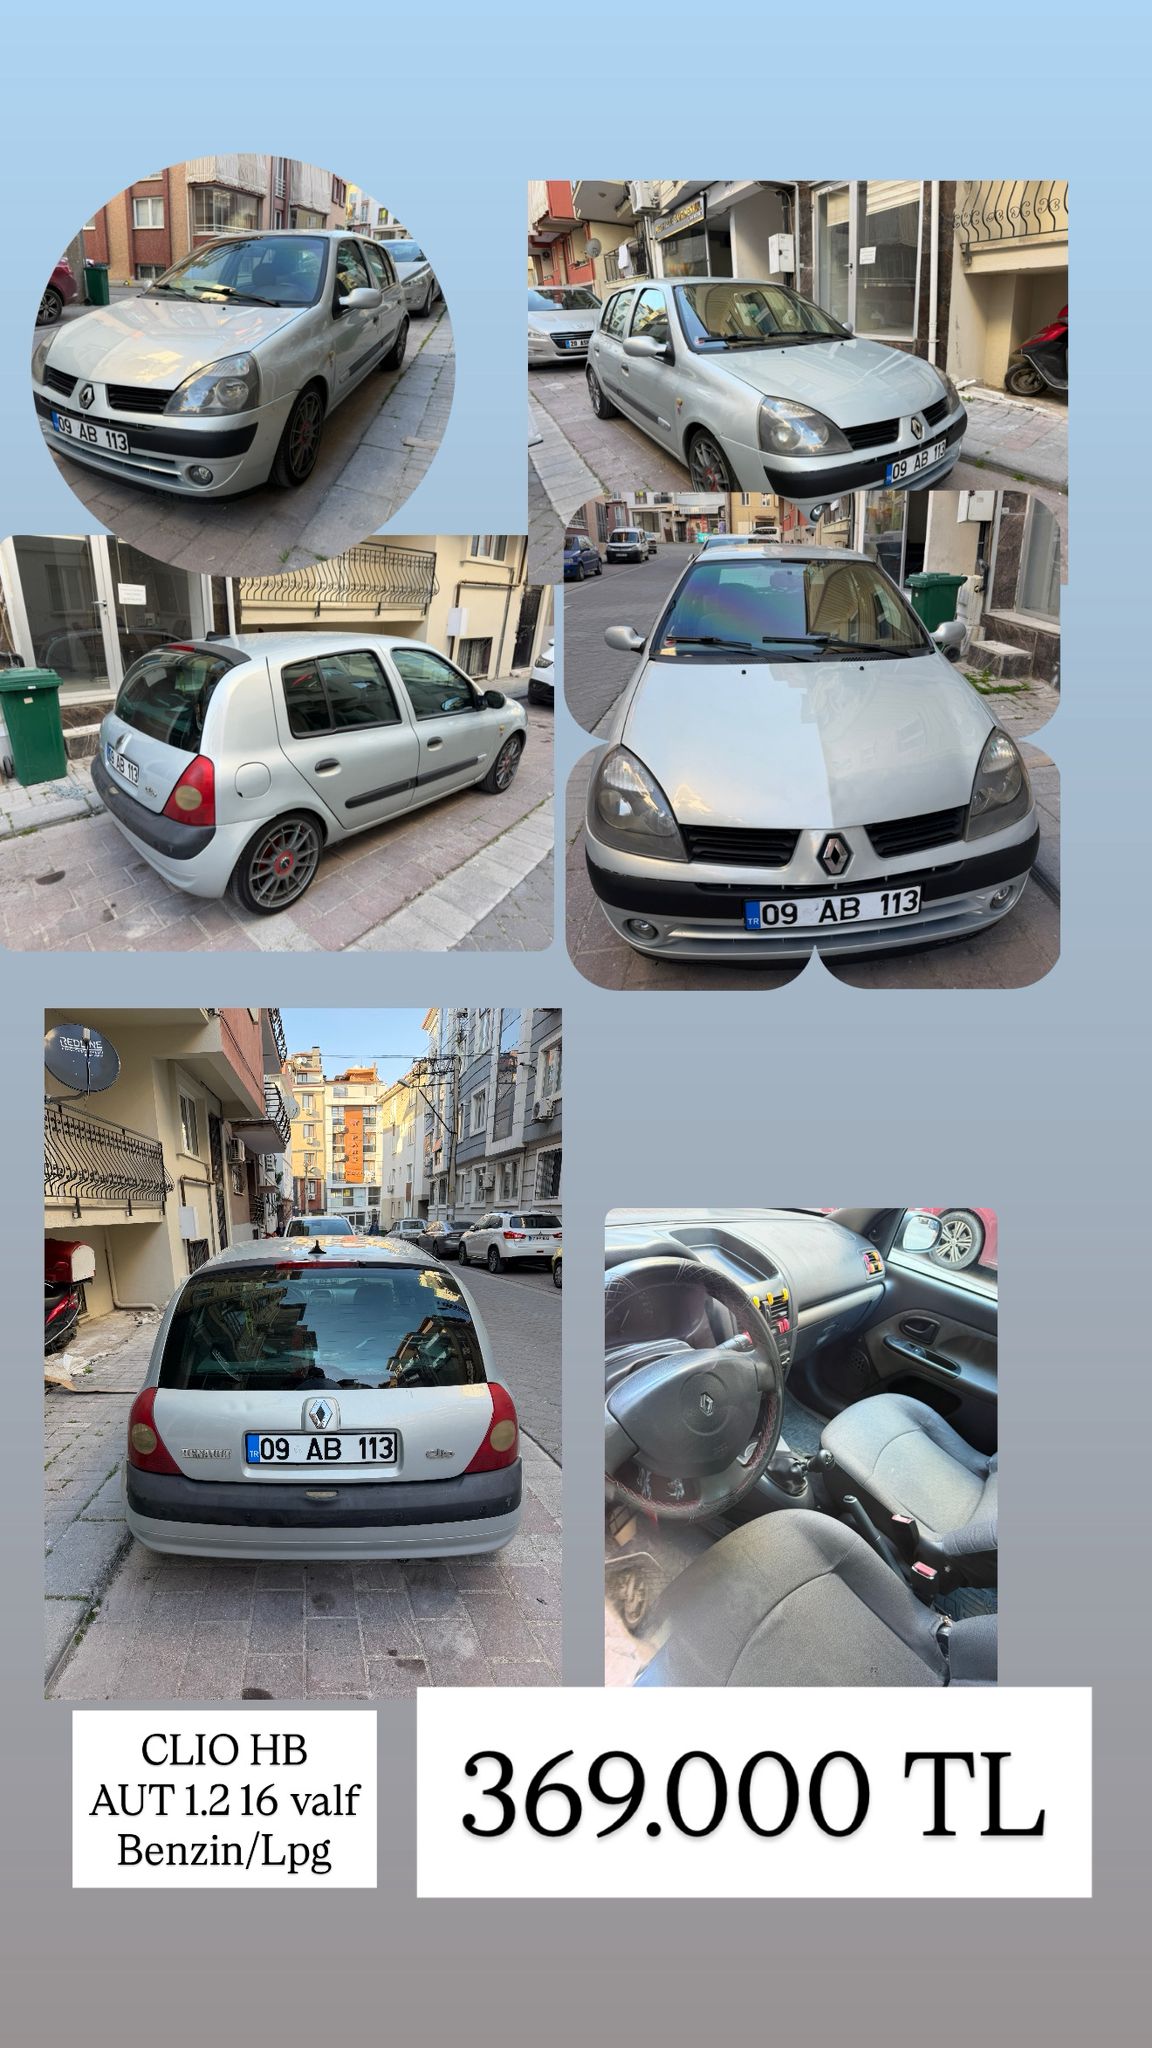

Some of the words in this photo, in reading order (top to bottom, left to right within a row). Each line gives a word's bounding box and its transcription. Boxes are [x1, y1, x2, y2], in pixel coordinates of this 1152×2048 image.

[58, 416, 72, 434] 09
[80, 423, 97, 443] AB
[106, 431, 127, 451] 113
[893, 461, 907, 479] 09
[914, 450, 928, 471] AB
[934, 441, 946, 460] 113
[116, 755, 124, 773] AB
[128, 763, 138, 783] 113
[762, 903, 797, 925] 09
[819, 897, 860, 923] AB
[881, 890, 918, 915] 113
[60, 1036, 103, 1049] REDLNE
[249, 1450, 259, 1458] TR
[261, 1438, 289, 1460] 09
[307, 1438, 341, 1460] AB
[359, 1437, 393, 1459] 113
